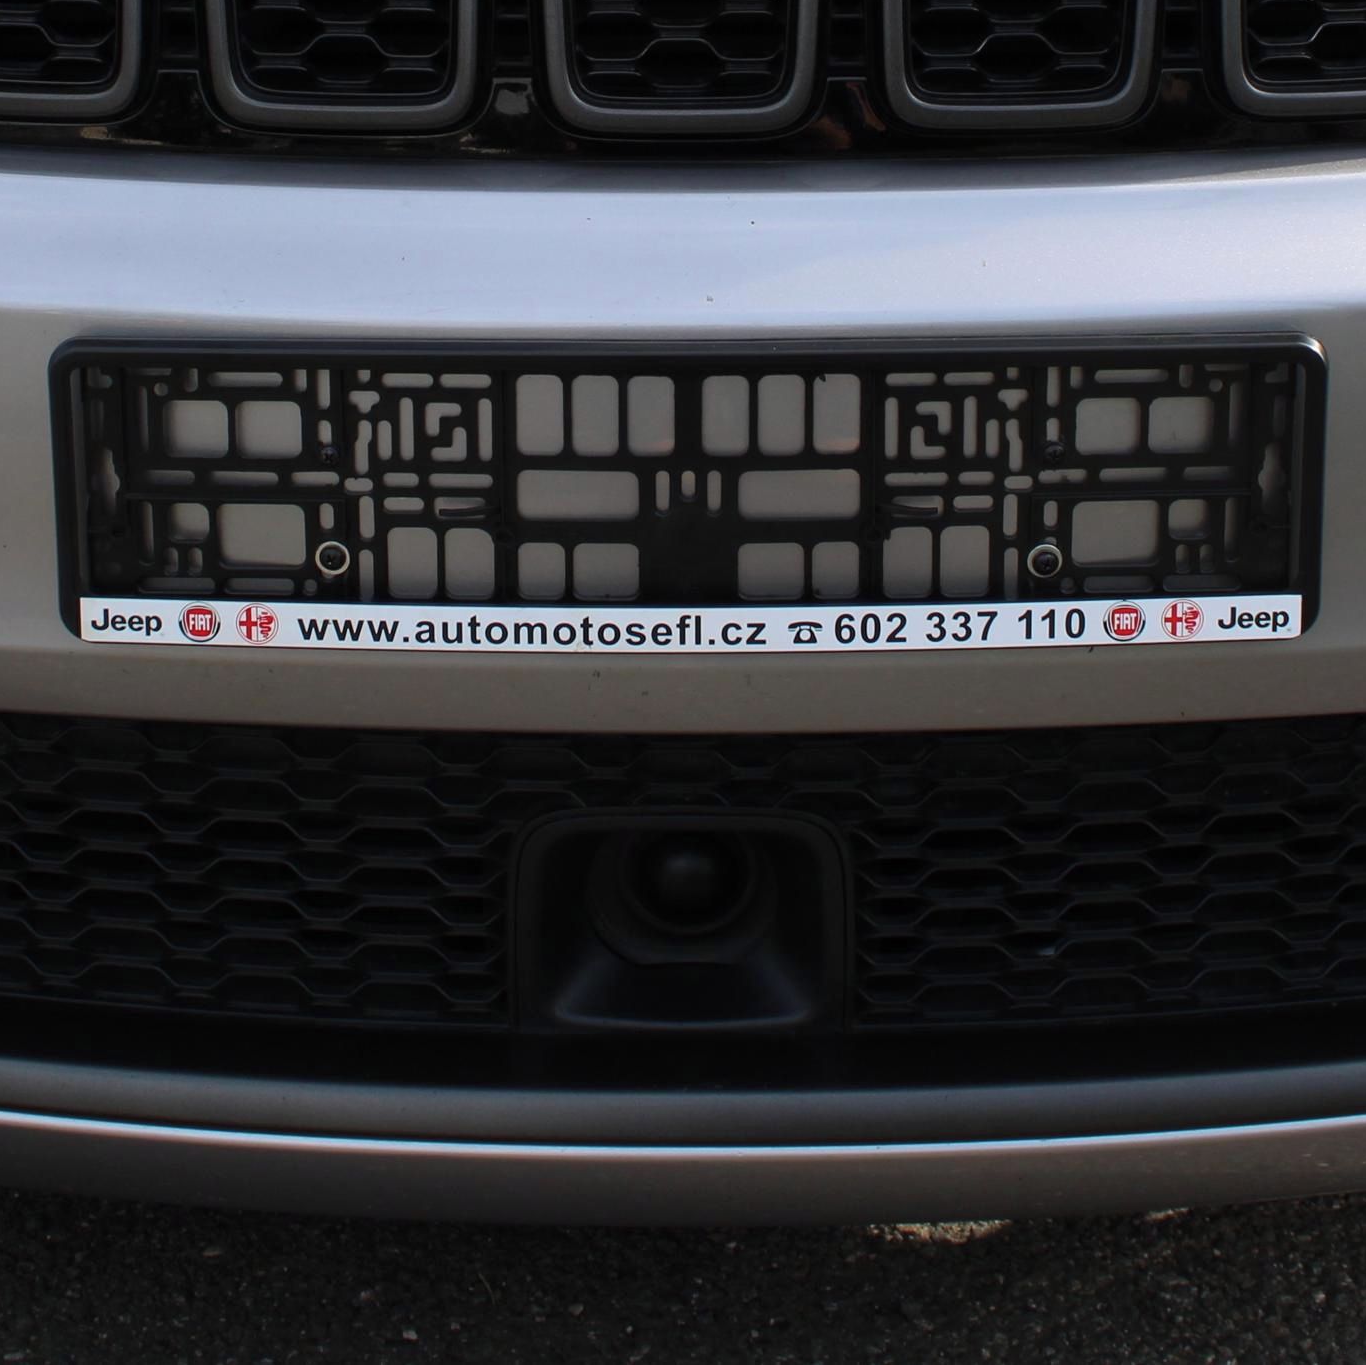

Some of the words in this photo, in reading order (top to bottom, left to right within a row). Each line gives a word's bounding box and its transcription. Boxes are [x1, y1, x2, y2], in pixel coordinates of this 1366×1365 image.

[91, 609, 163, 636] Jeep
[188, 613, 213, 631] FIAT
[297, 615, 767, 646] www.automotosefl.cz
[835, 613, 908, 644] 602
[925, 610, 999, 642] 337
[1017, 608, 1086, 640] 110
[1113, 613, 1138, 631] FIAT
[1218, 606, 1290, 632] Jeep
